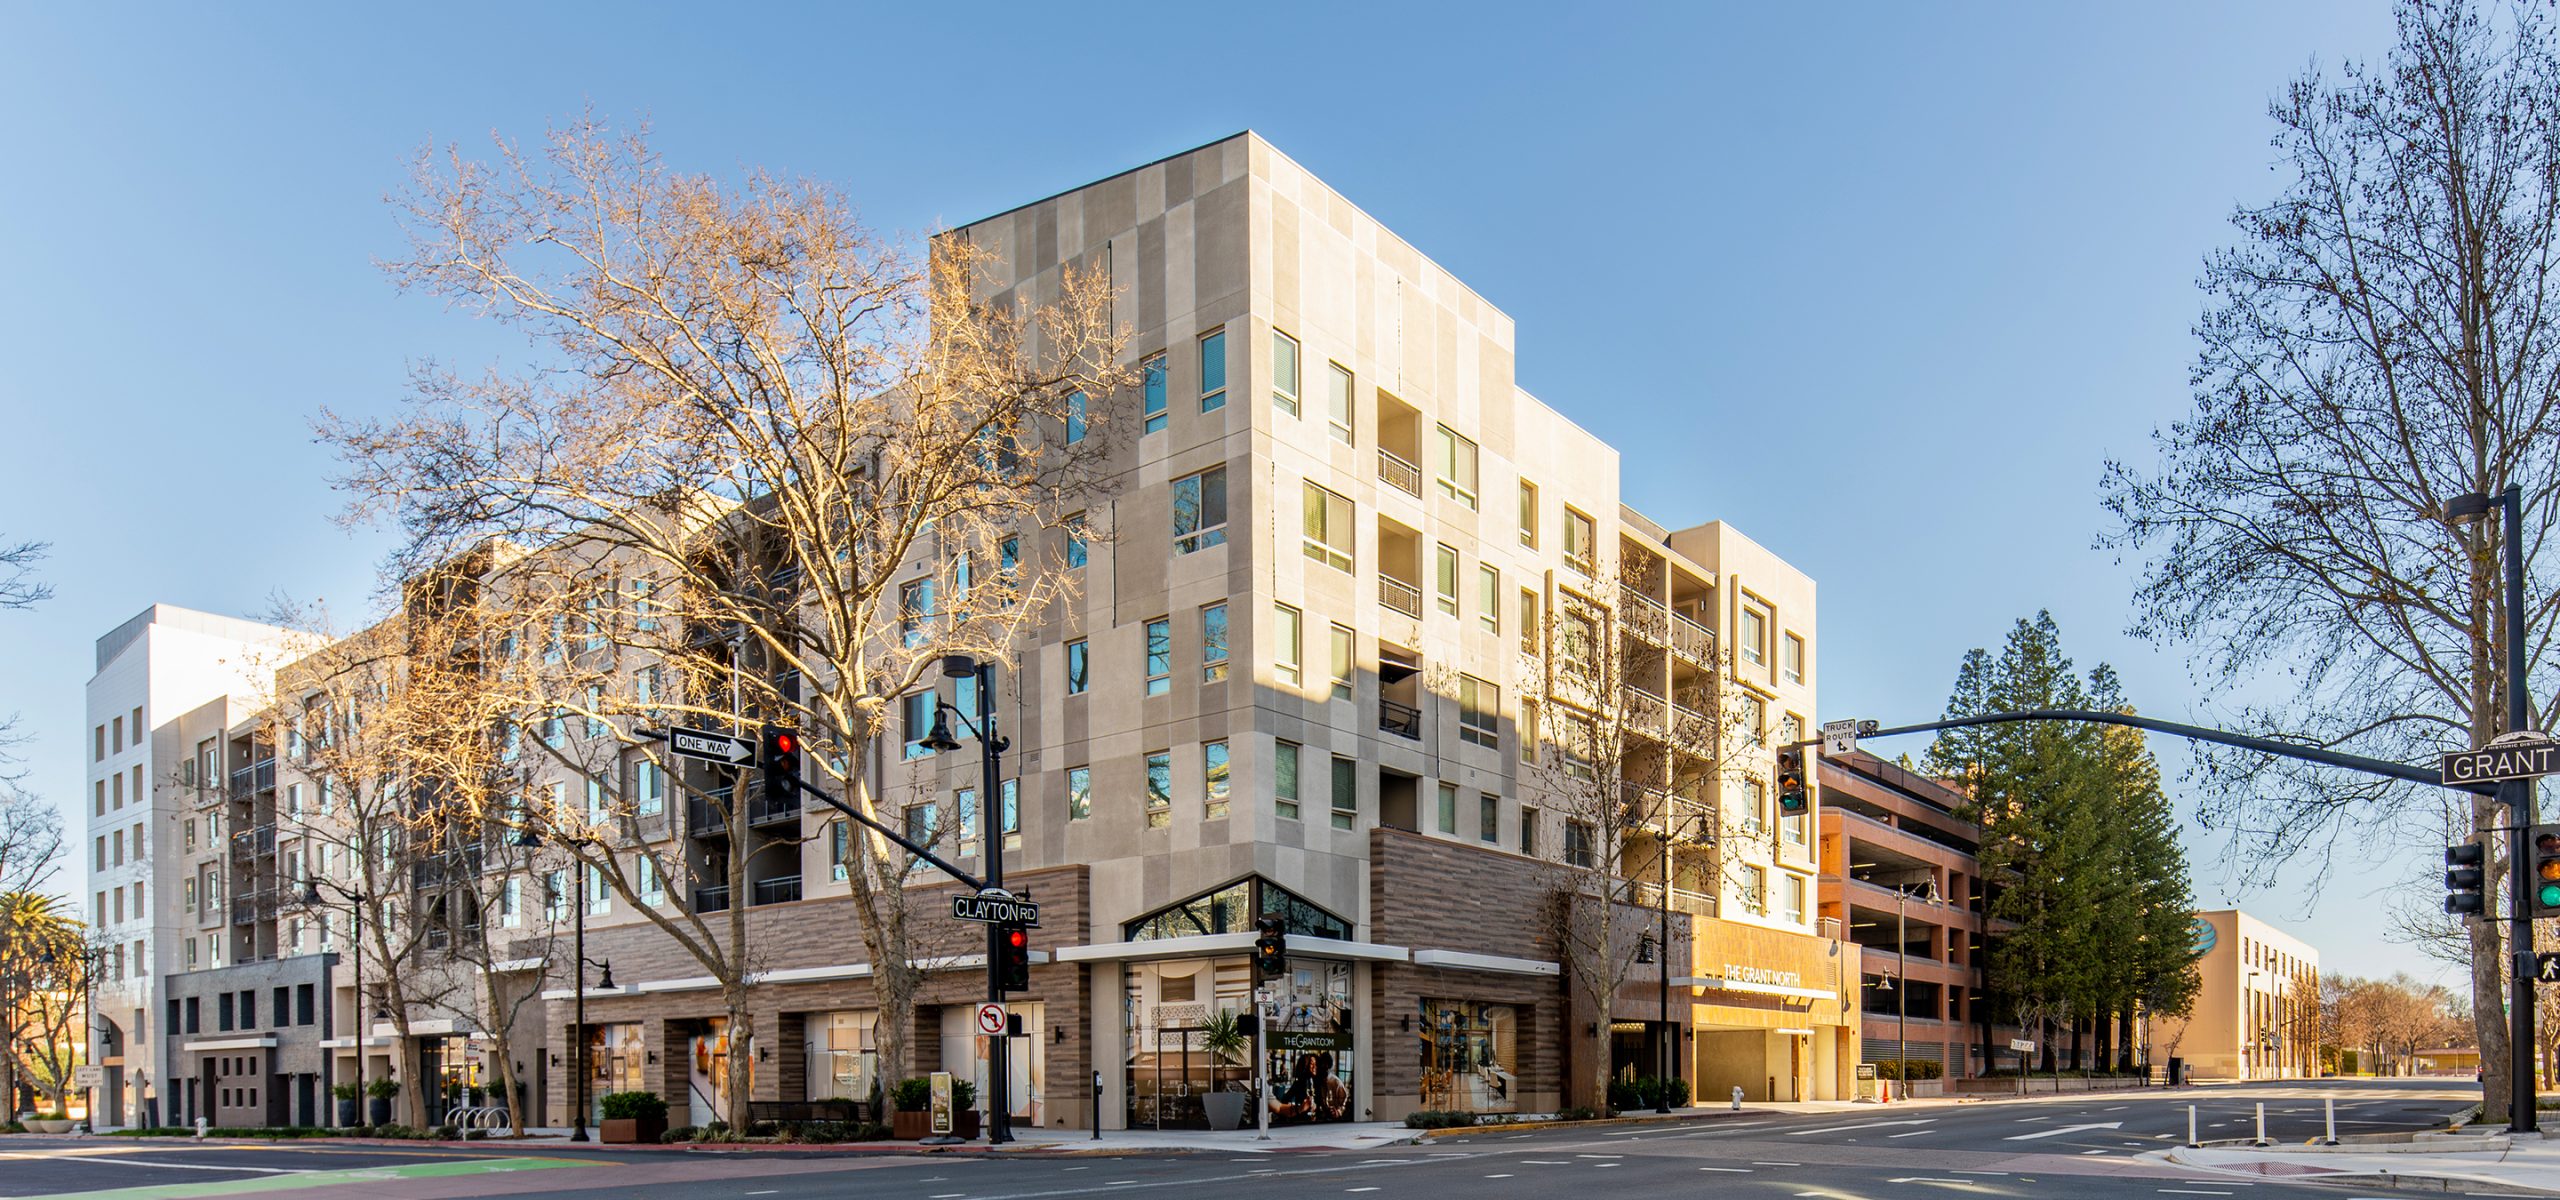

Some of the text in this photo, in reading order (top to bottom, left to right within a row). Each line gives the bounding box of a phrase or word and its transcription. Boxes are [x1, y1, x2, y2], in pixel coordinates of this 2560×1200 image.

[1826, 722, 1853, 731] TRUCK
[1826, 732, 1853, 741] ROUTE
[680, 736, 730, 754] ONE WAY
[2454, 747, 2554, 779] GRANT
[956, 899, 1036, 921] CLAYTON RD
[1724, 963, 1800, 987] THE GRANT NORTH
